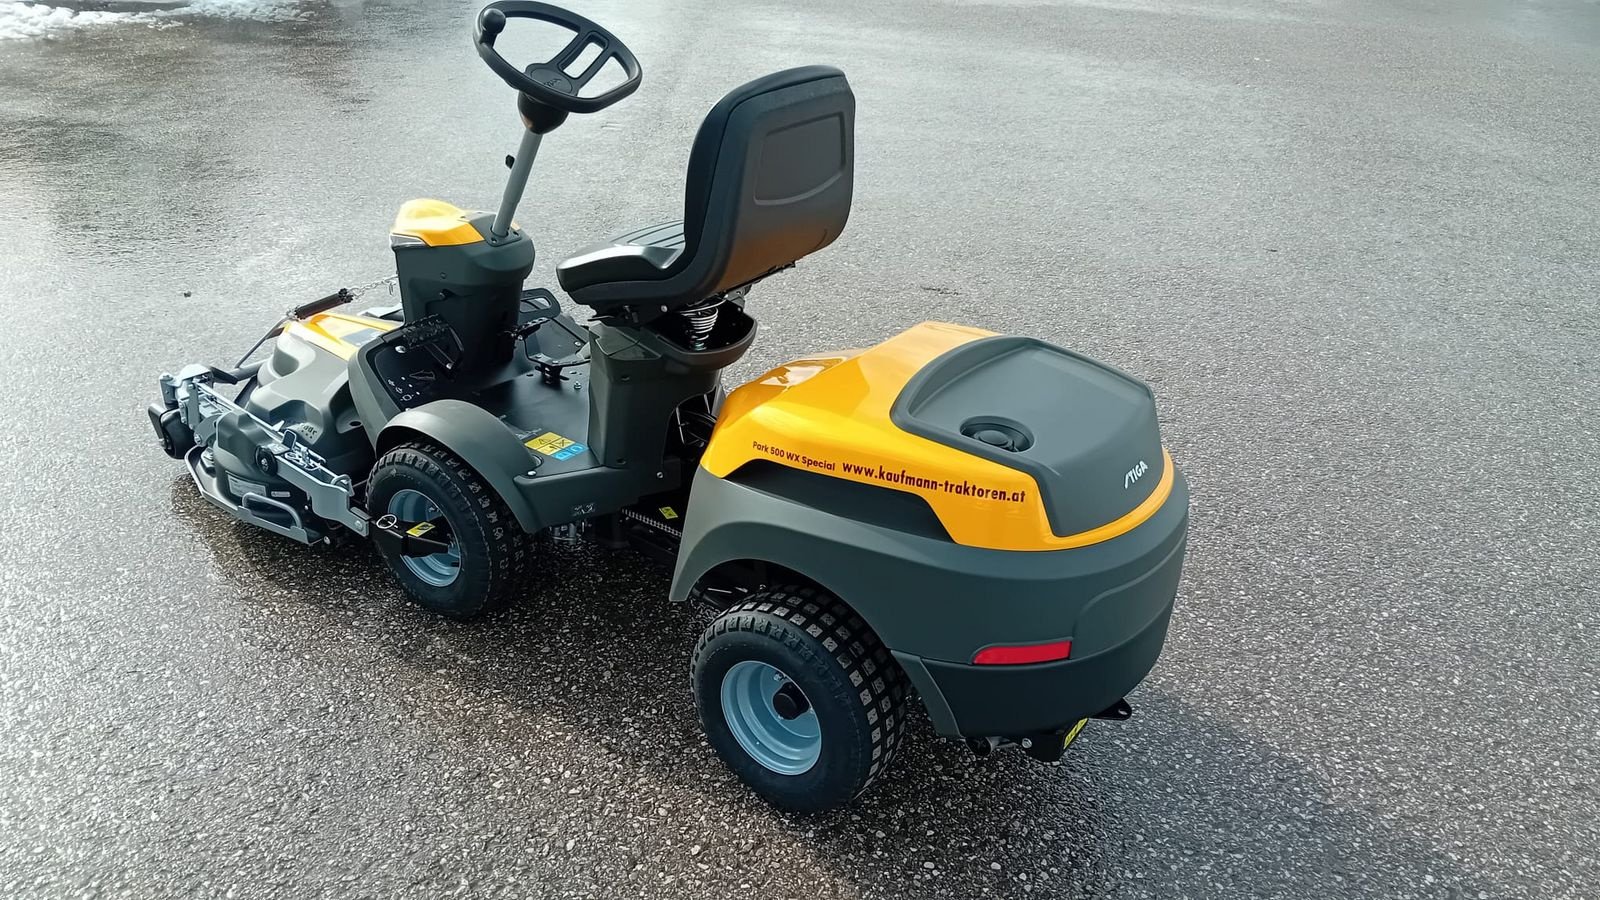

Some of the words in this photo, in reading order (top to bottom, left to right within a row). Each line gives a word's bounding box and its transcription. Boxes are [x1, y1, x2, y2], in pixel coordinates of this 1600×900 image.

[752, 441, 769, 453] Park
[770, 446, 785, 458] 500
[786, 451, 801, 463] WX
[801, 456, 836, 471] Special
[842, 462, 1026, 502] www.kaufmann-traktoren.at
